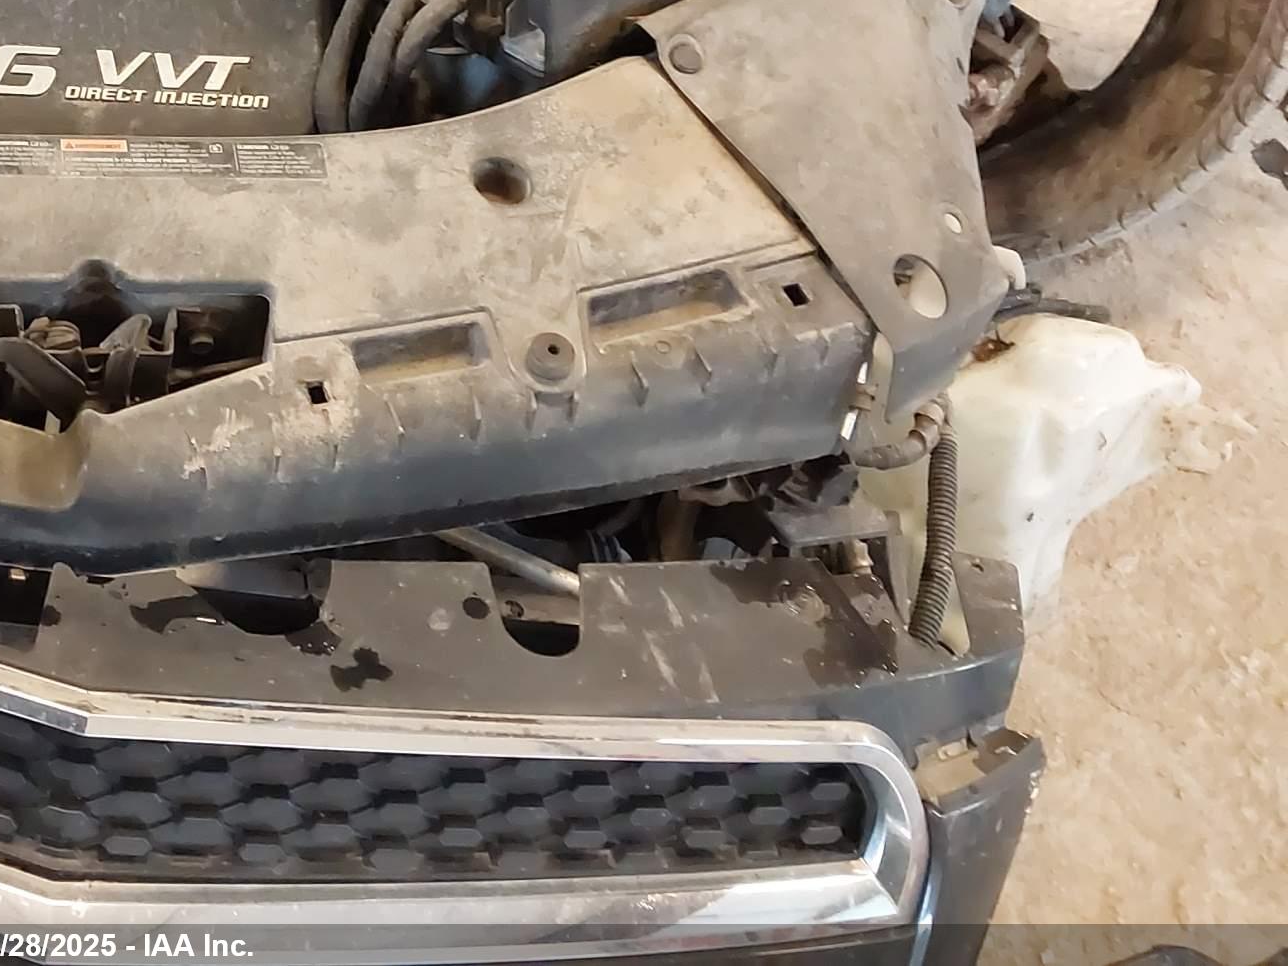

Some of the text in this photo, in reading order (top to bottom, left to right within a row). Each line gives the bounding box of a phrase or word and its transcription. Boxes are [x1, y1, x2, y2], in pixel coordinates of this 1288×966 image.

[96, 49, 251, 91] VVT
[65, 85, 269, 110] DIRECT INJECTION
